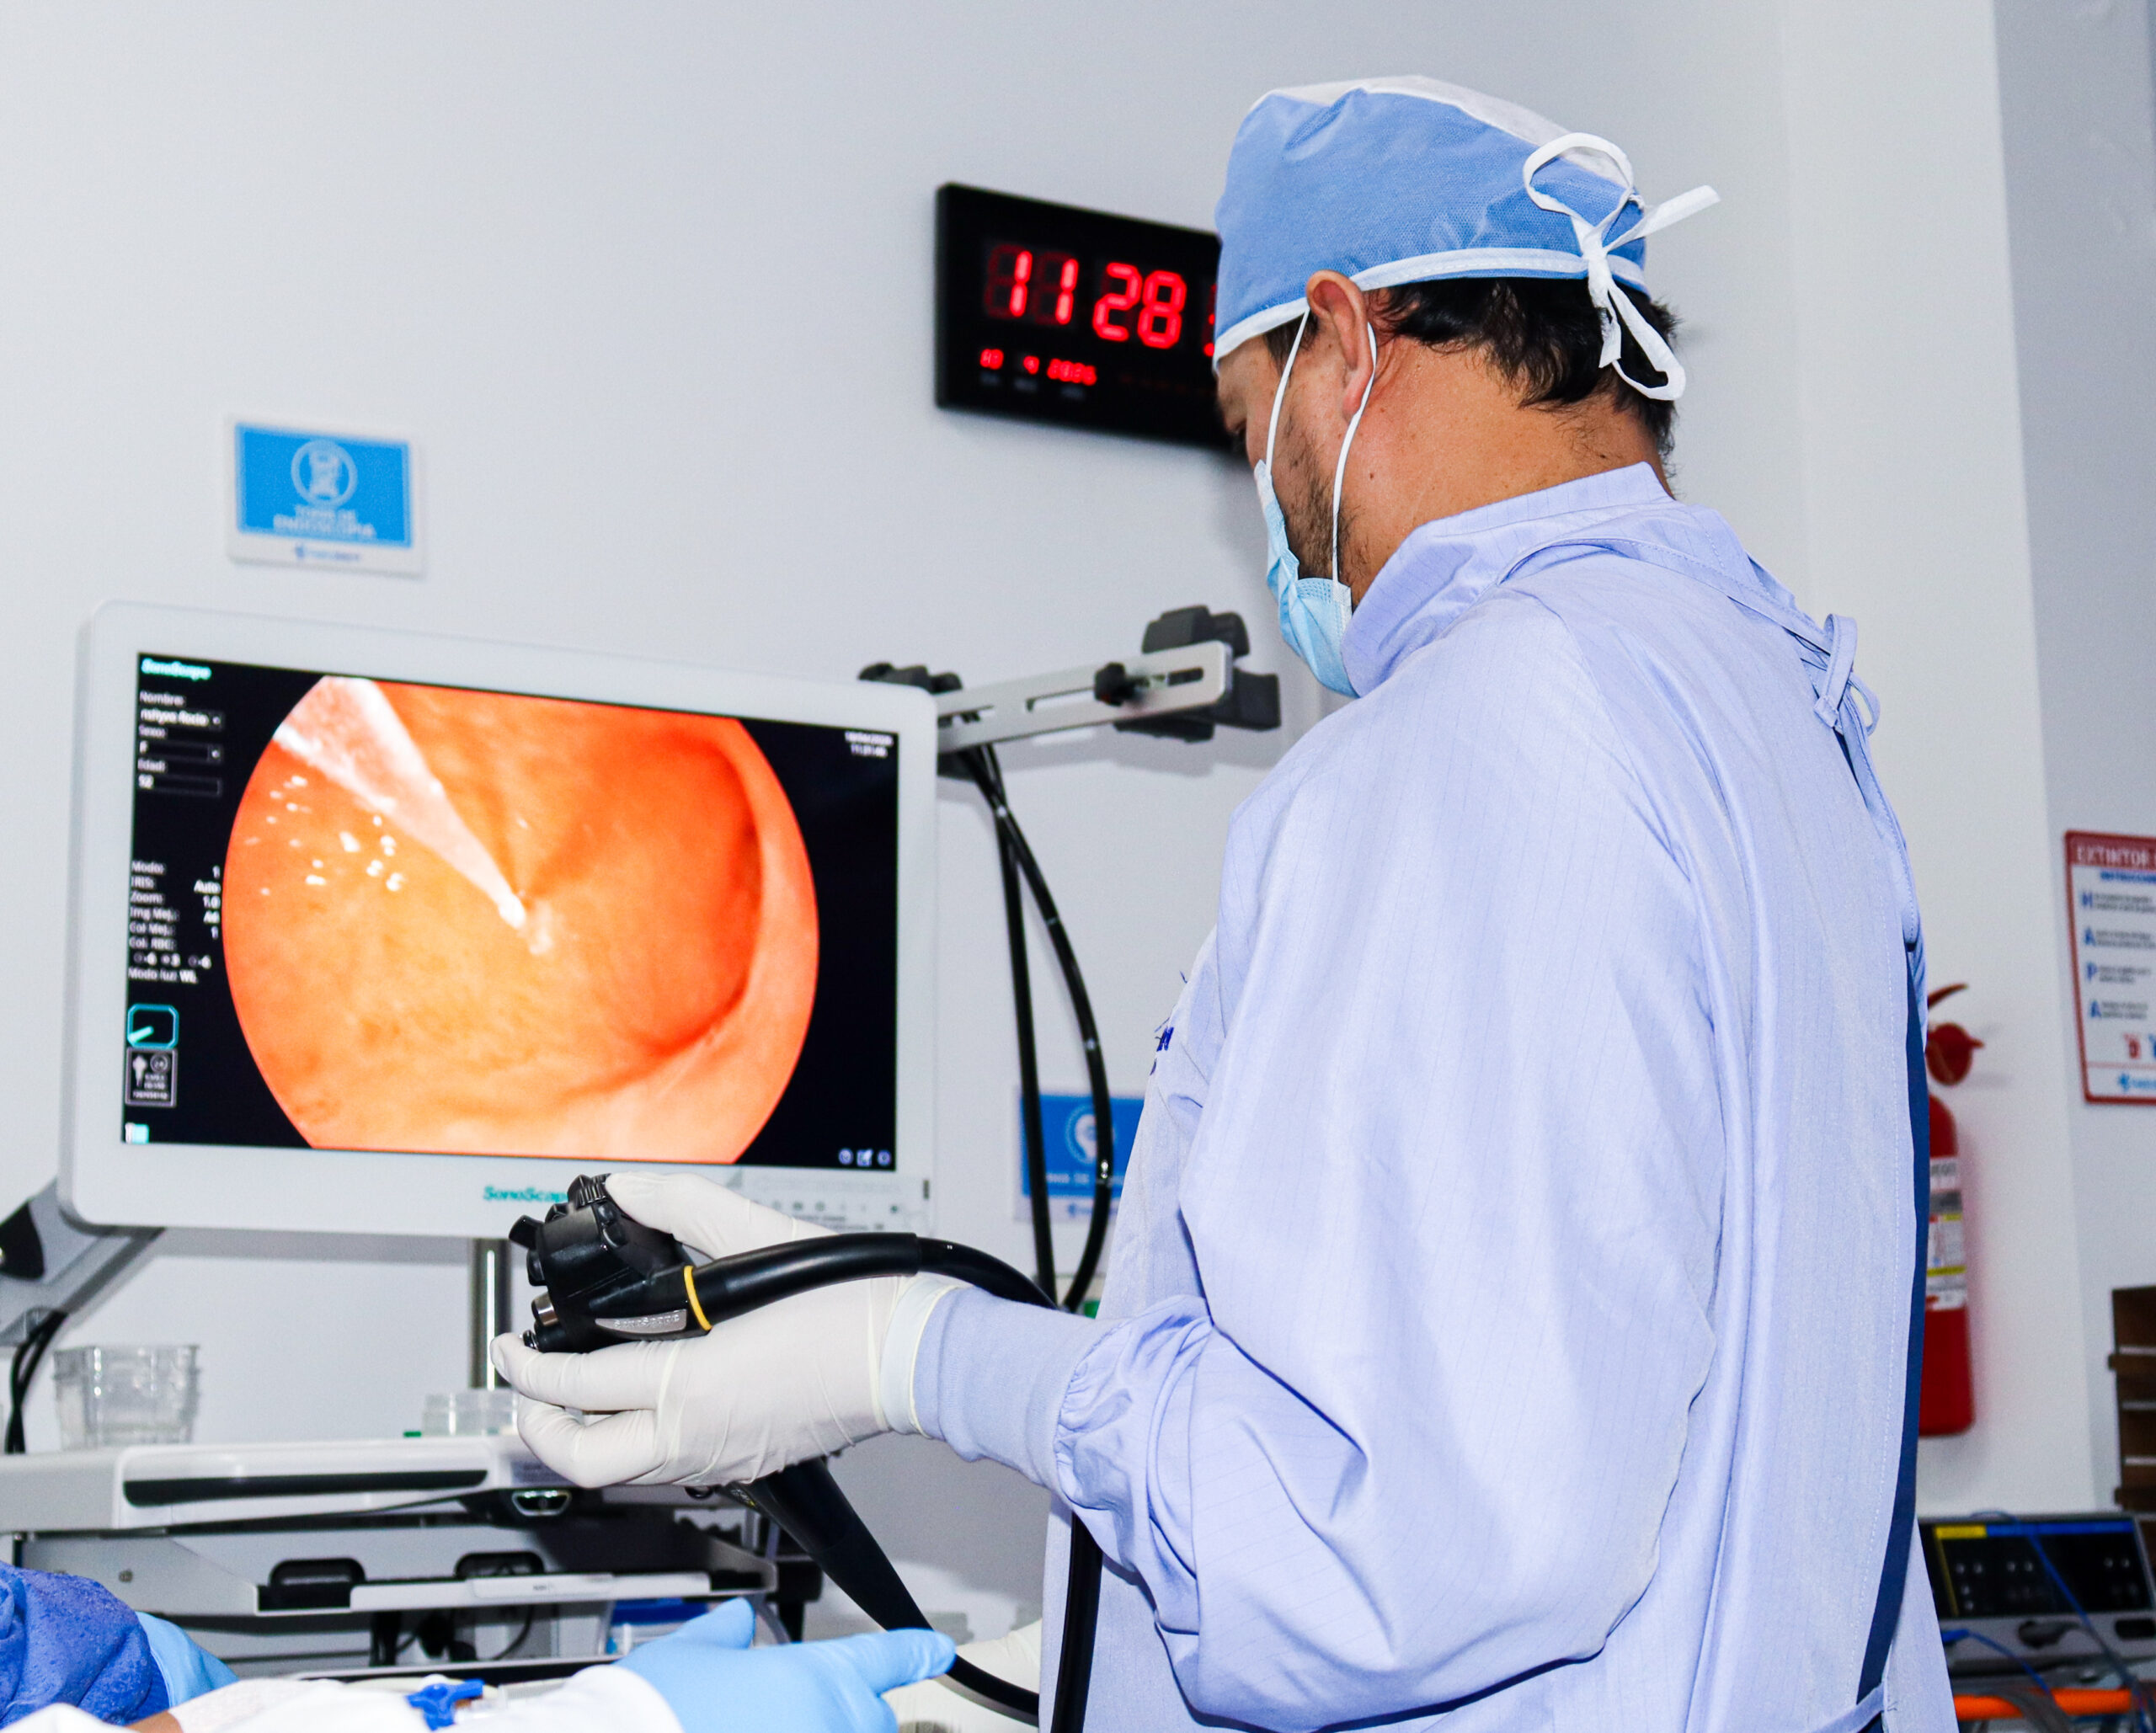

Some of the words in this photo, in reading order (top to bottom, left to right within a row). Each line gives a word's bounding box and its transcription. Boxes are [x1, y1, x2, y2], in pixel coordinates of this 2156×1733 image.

[1010, 251, 1078, 325] 11
[1092, 262, 1187, 349] 28
[194, 879, 221, 893] Auto
[483, 1186, 568, 1203] SonoScap
